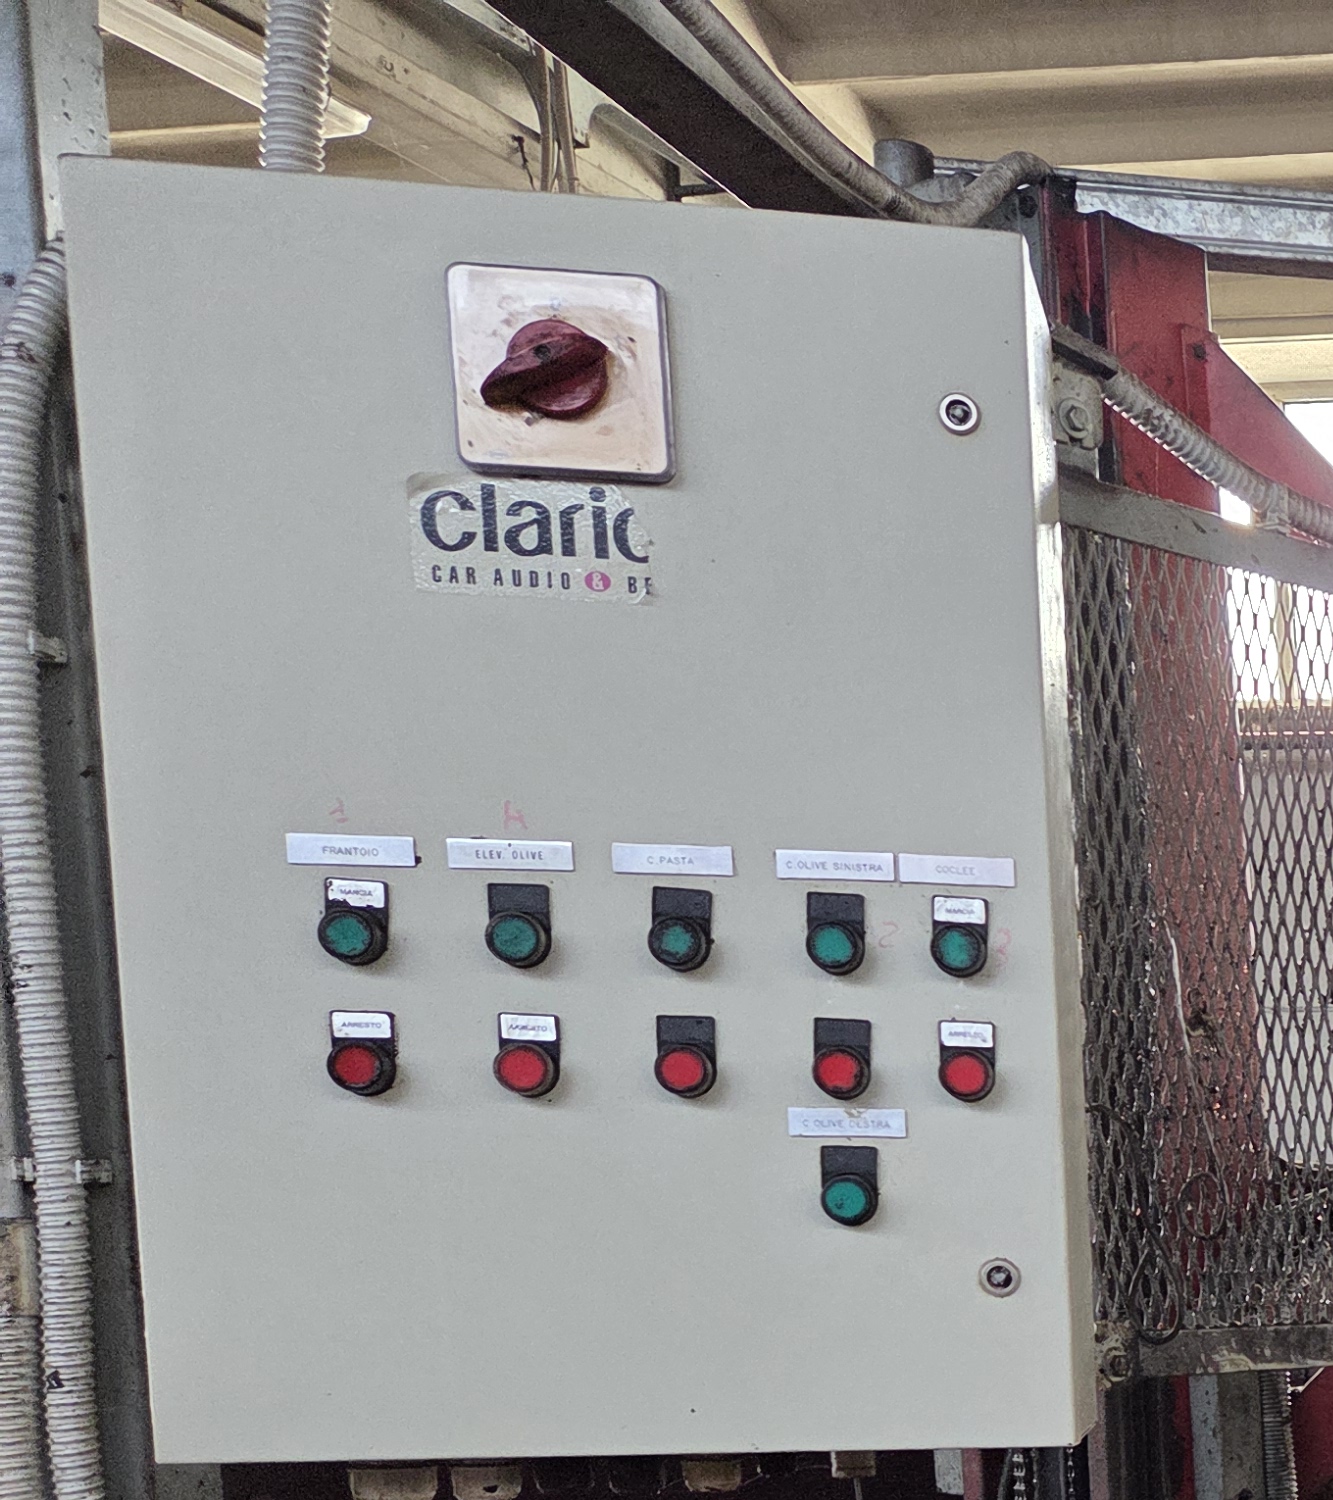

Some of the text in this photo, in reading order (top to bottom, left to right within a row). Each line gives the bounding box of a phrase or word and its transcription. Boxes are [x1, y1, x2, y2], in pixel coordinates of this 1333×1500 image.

[431, 564, 477, 585] CAR
[493, 568, 571, 590] AUDIO
[588, 571, 608, 591] &
[321, 845, 380, 858] FRANTOIO
[511, 849, 545, 862] OLIVE
[832, 861, 885, 873] SINISTRA
[340, 1020, 383, 1030] ARRESTO
[848, 1119, 892, 1130] DESTRA
